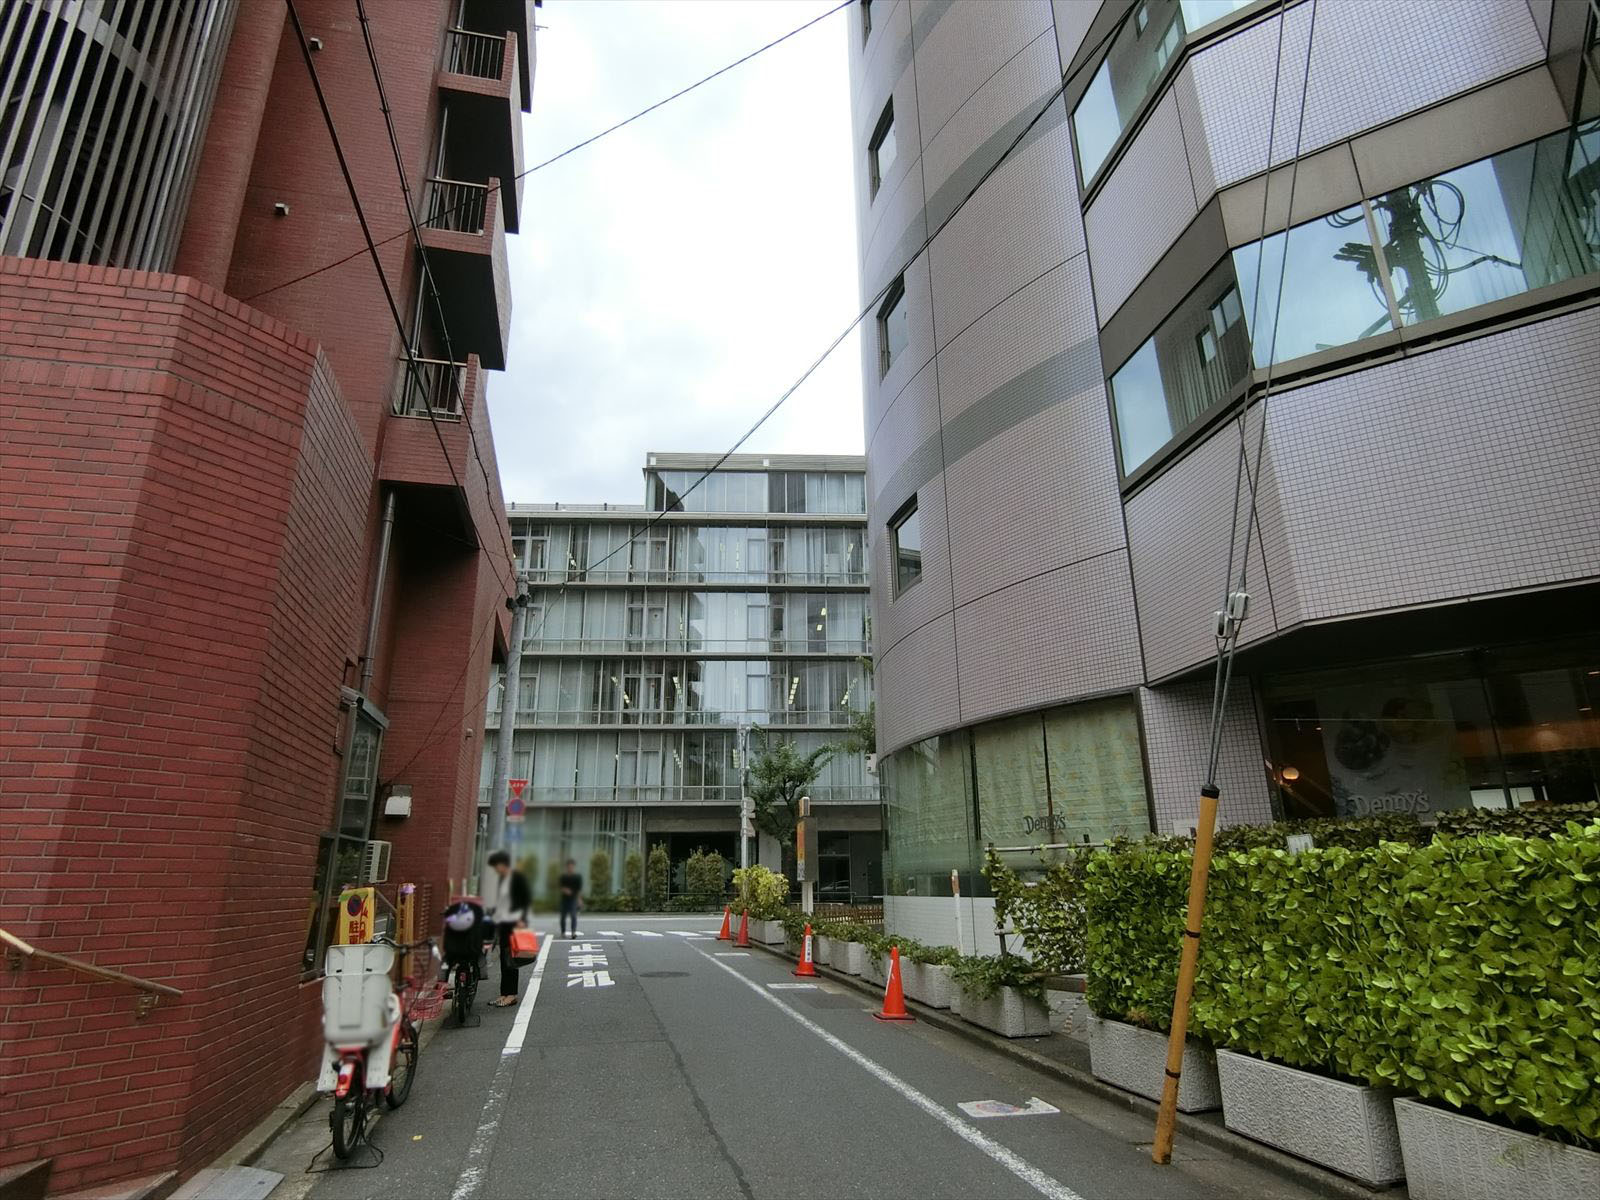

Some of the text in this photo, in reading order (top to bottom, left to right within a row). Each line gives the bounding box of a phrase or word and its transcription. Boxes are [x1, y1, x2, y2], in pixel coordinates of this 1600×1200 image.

[1347, 789, 1431, 816] Denny's
[1023, 811, 1066, 835] Denny's
[567, 944, 615, 988] 止まれ
